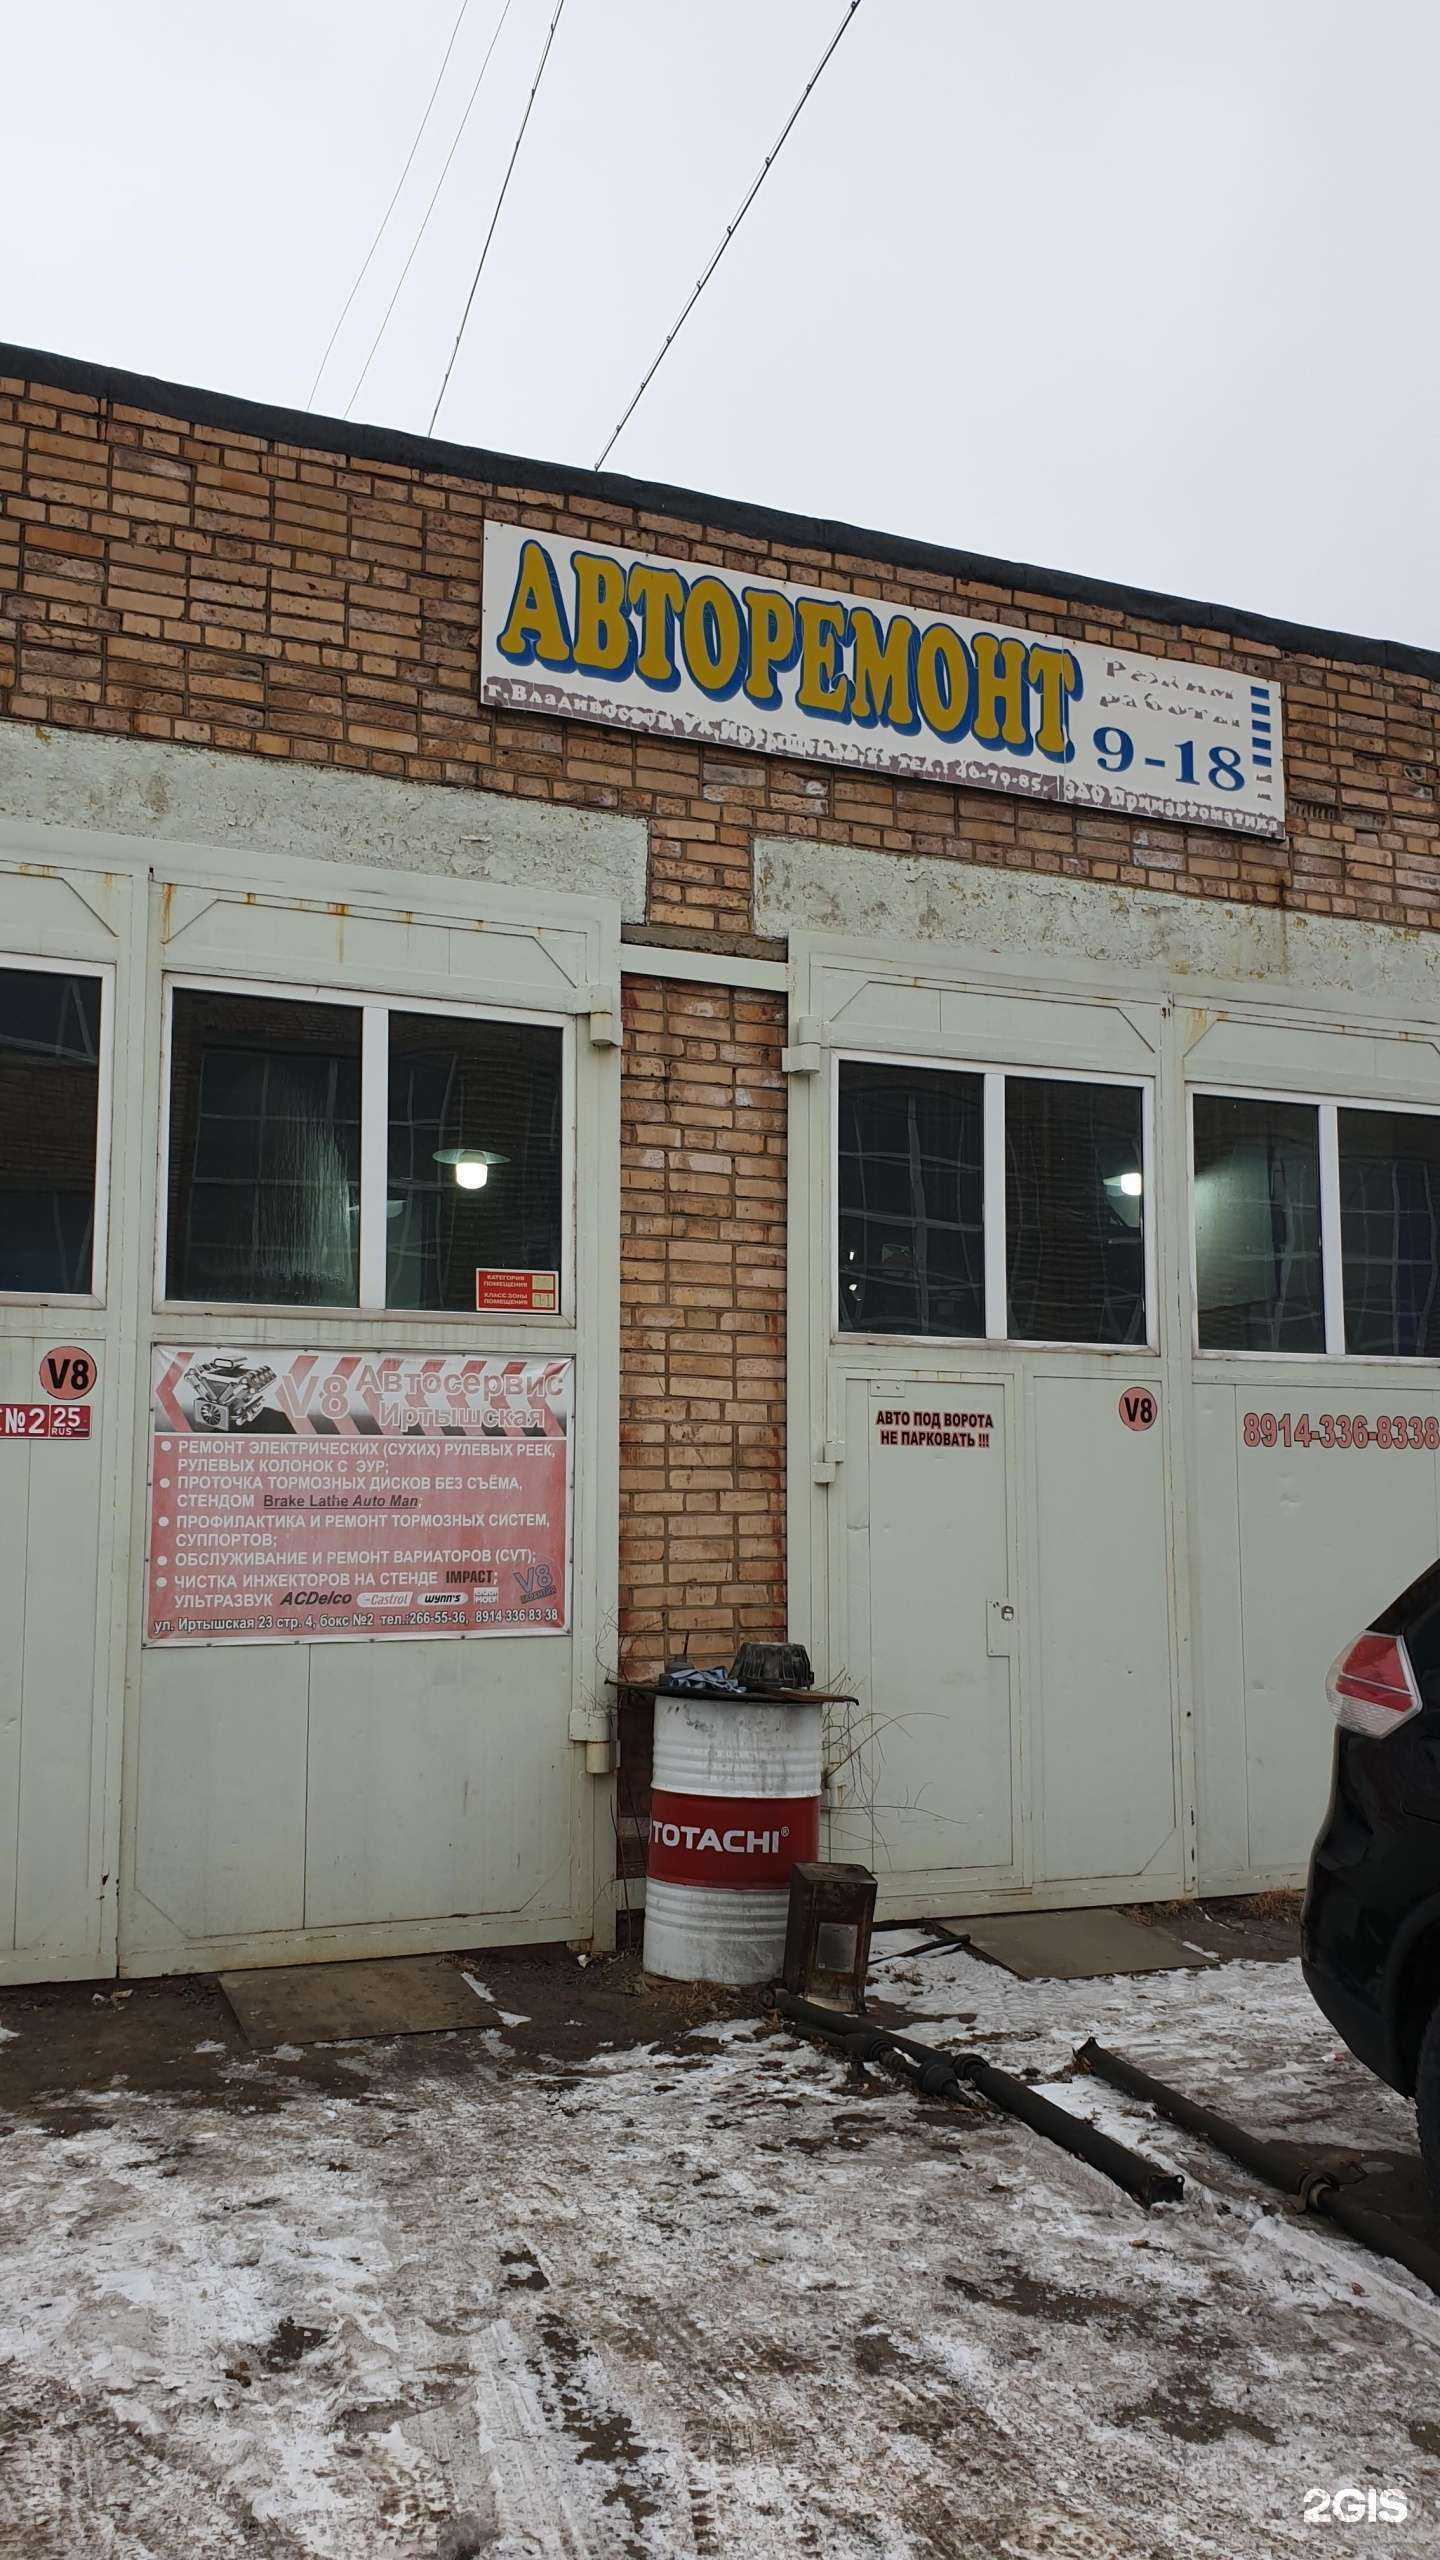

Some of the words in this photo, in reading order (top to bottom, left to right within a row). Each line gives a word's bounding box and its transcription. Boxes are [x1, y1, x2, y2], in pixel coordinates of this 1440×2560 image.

[497, 540, 1084, 765] АВТОРЕМОНТ
[1092, 726, 1246, 792] 9-18
[47, 1358, 89, 1391] V8
[354, 1363, 565, 1401] Автосервис
[279, 1373, 351, 1420] V8
[53, 1407, 80, 1428] 25
[378, 1400, 546, 1433] Иртышская
[876, 1410, 911, 1426] АВТО
[914, 1412, 941, 1430] ПОД
[944, 1413, 994, 1429] ВОРОТА
[1123, 1396, 1153, 1424] V8
[51, 1427, 72, 1436] RUS
[880, 1430, 898, 1446] НЕ
[901, 1431, 975, 1448] ПАРКОВАТЬ
[1243, 1412, 1440, 1450] 8914-336-8338
[178, 1440, 245, 1454] РЕМОНТ
[249, 1440, 379, 1456] ЭЛЕКТРИЧЕСКИХ
[383, 1441, 441, 1458] (СУХИХ)
[445, 1443, 513, 1457] РУЛЕВЫХ
[516, 1443, 556, 1458] РЕЕК,
[177, 1459, 256, 1473] РУЛЕВЫХ
[259, 1459, 333, 1473] КОЛОНОК
[337, 1460, 348, 1473] С
[355, 1459, 390, 1475] ЭУР;
[177, 1475, 264, 1489] ПРОТОЧКА
[267, 1475, 367, 1490] ТОРМОЗНЫХ
[369, 1476, 431, 1492] ДИСКОВ
[435, 1477, 463, 1490] БЕЗ
[467, 1475, 523, 1491] СЪЁМА,
[176, 1493, 255, 1510] СТЕНДОМ
[263, 1494, 305, 1508] Brake
[310, 1494, 348, 1508] Lathe
[352, 1494, 386, 1508] Auto
[175, 1514, 306, 1529] ПРОФИЛАКТИКА
[310, 1515, 321, 1528] И
[325, 1514, 388, 1528] РЕМОНТ
[391, 1513, 485, 1527] ТОРМОЗНЫХ
[489, 1513, 550, 1528] СИСТЕМ,
[175, 1533, 278, 1548] СУППОРТОВ;
[175, 1551, 308, 1567] ОБСЛУЖИВАНИЕ
[312, 1552, 322, 1565] И
[327, 1551, 390, 1565] РЕМОНТ
[393, 1550, 491, 1564] ВАРИАТОРОВ
[495, 1548, 537, 1565] (CVT);
[174, 1574, 238, 1589] ЧИСТКА
[242, 1573, 350, 1588] ИНЖЕКТОРОВ
[354, 1573, 375, 1586] НА
[379, 1571, 438, 1587] СТЕНДЕ
[512, 1563, 553, 1594] V8
[174, 1593, 273, 1609] УЛЬТРАЗВУК
[280, 1590, 353, 1606] ACDelco
[370, 1592, 408, 1606] Castrol
[154, 1619, 174, 1633] ул.
[178, 1616, 255, 1632] Иртышская
[258, 1615, 273, 1629] 23
[276, 1618, 302, 1631] стр.
[305, 1615, 316, 1629] 4,
[319, 1614, 349, 1628] бокс
[352, 1613, 375, 1627] №2
[475, 1609, 503, 1623] 8914
[506, 1609, 526, 1622] 336
[528, 1608, 543, 1622] 83
[545, 1608, 559, 1621] 38
